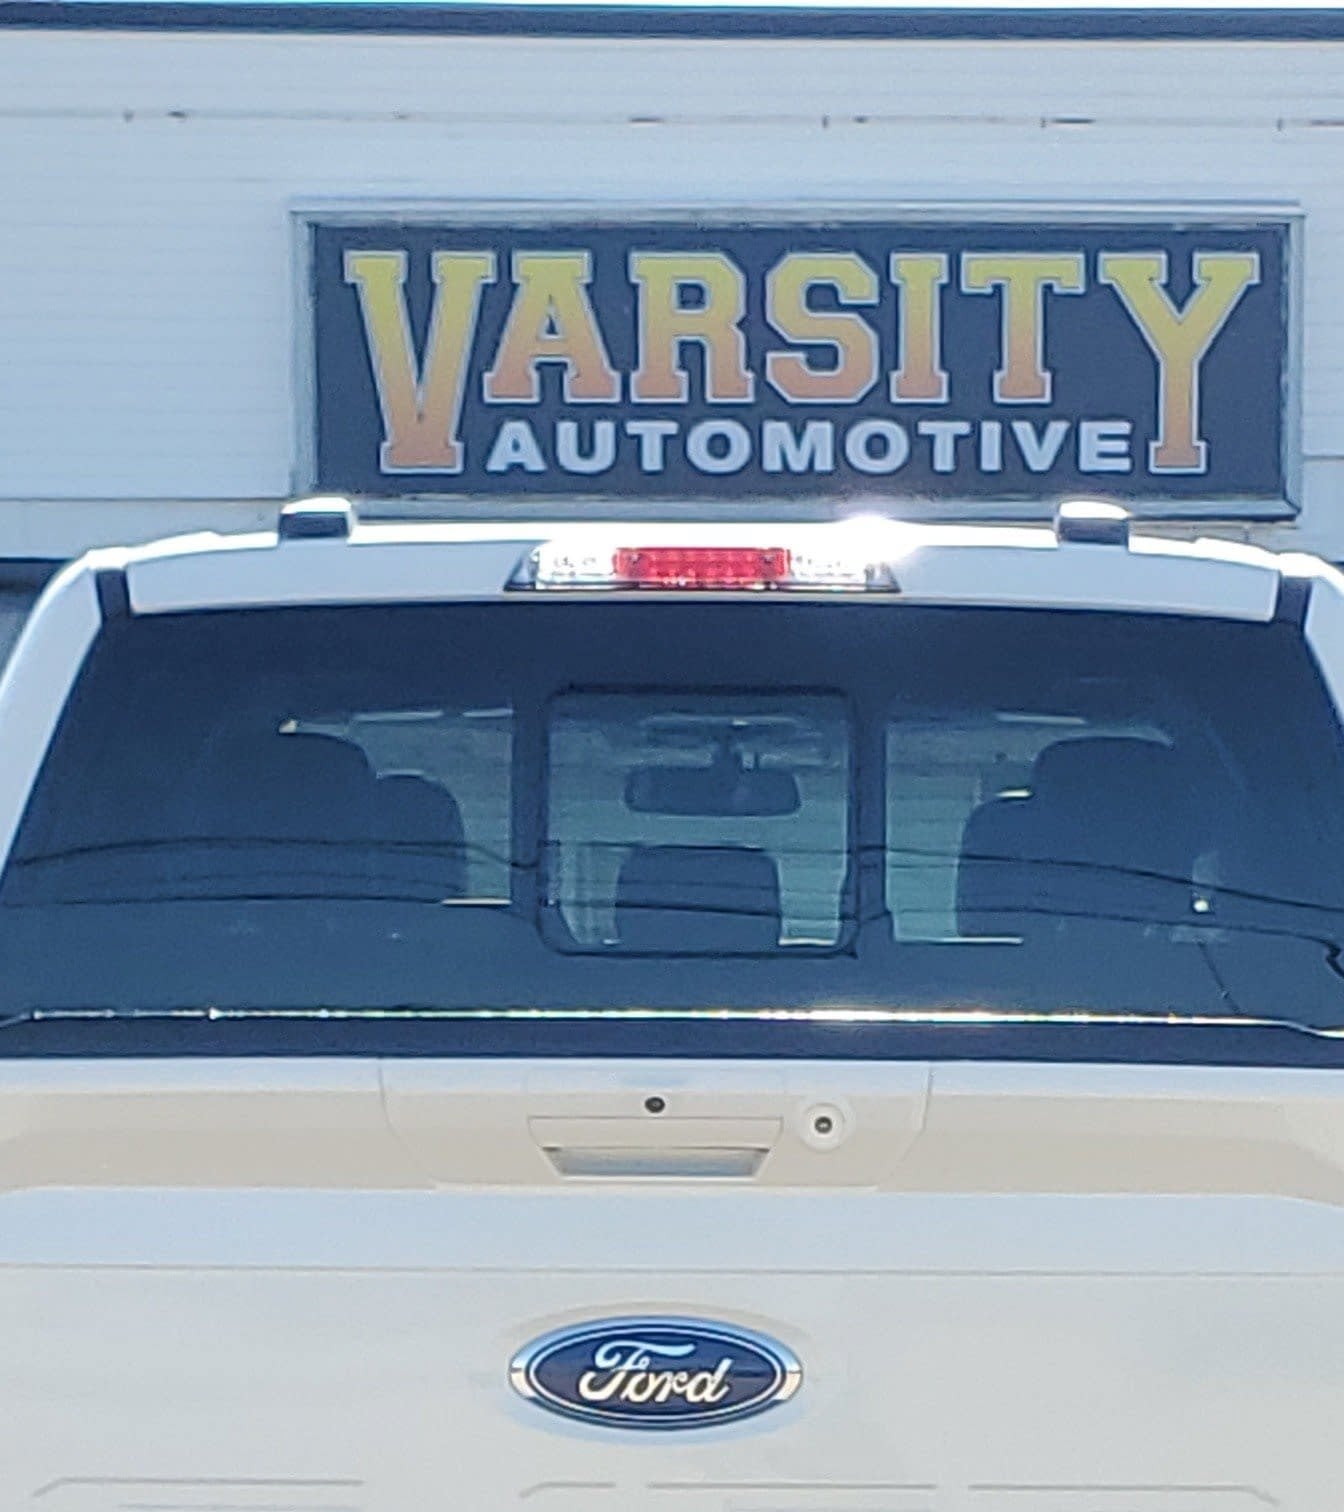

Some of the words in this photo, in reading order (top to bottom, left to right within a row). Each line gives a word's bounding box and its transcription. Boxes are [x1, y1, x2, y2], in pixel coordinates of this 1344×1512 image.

[343, 250, 1261, 474] VARSITY
[487, 418, 1133, 474] AUTOMOTIVE
[578, 1340, 731, 1403] Ford
